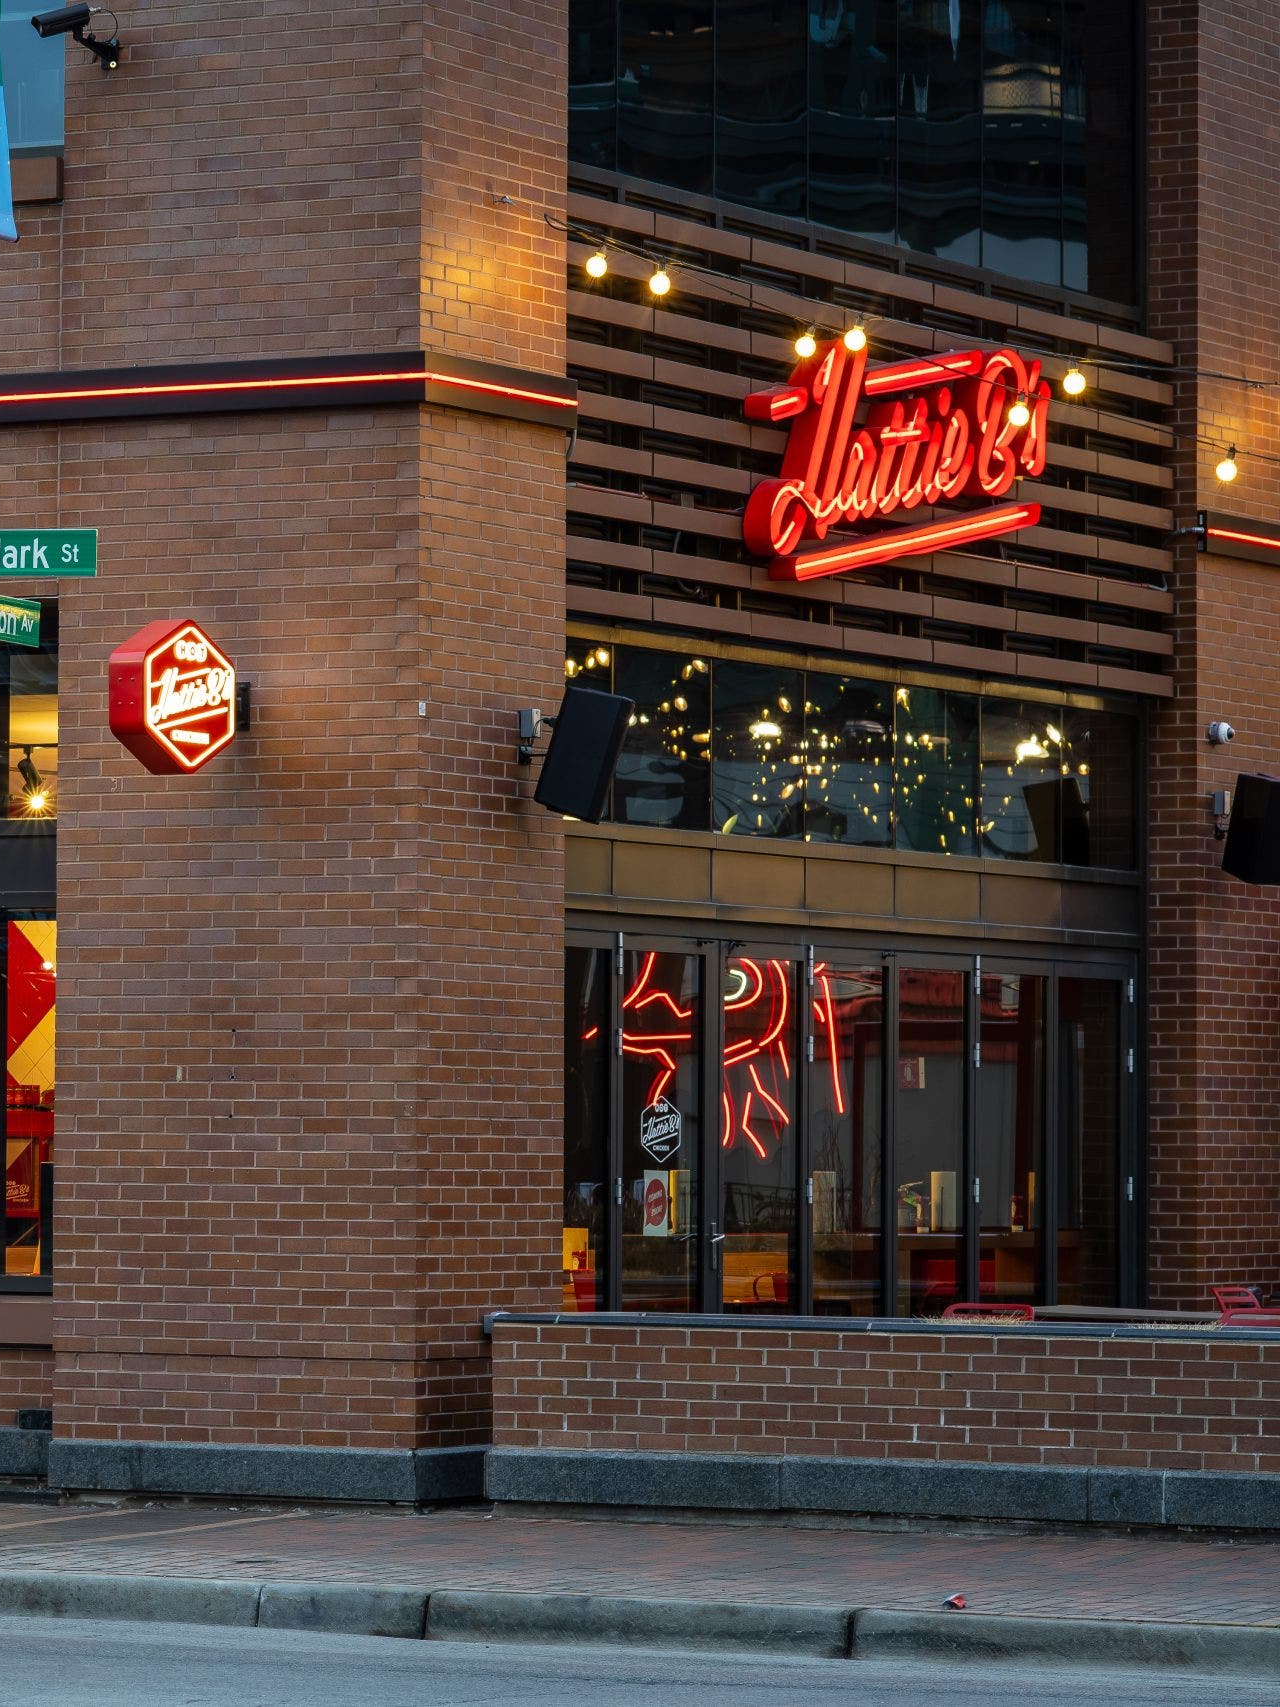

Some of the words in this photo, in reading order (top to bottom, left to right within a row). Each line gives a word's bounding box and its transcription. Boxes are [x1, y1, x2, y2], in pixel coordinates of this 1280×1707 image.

[744, 339, 973, 556] Hattie
[977, 350, 1052, 496] B's
[61, 543, 79, 563] St
[20, 616, 34, 633] Av
[643, 1116, 669, 1143] Hattie
